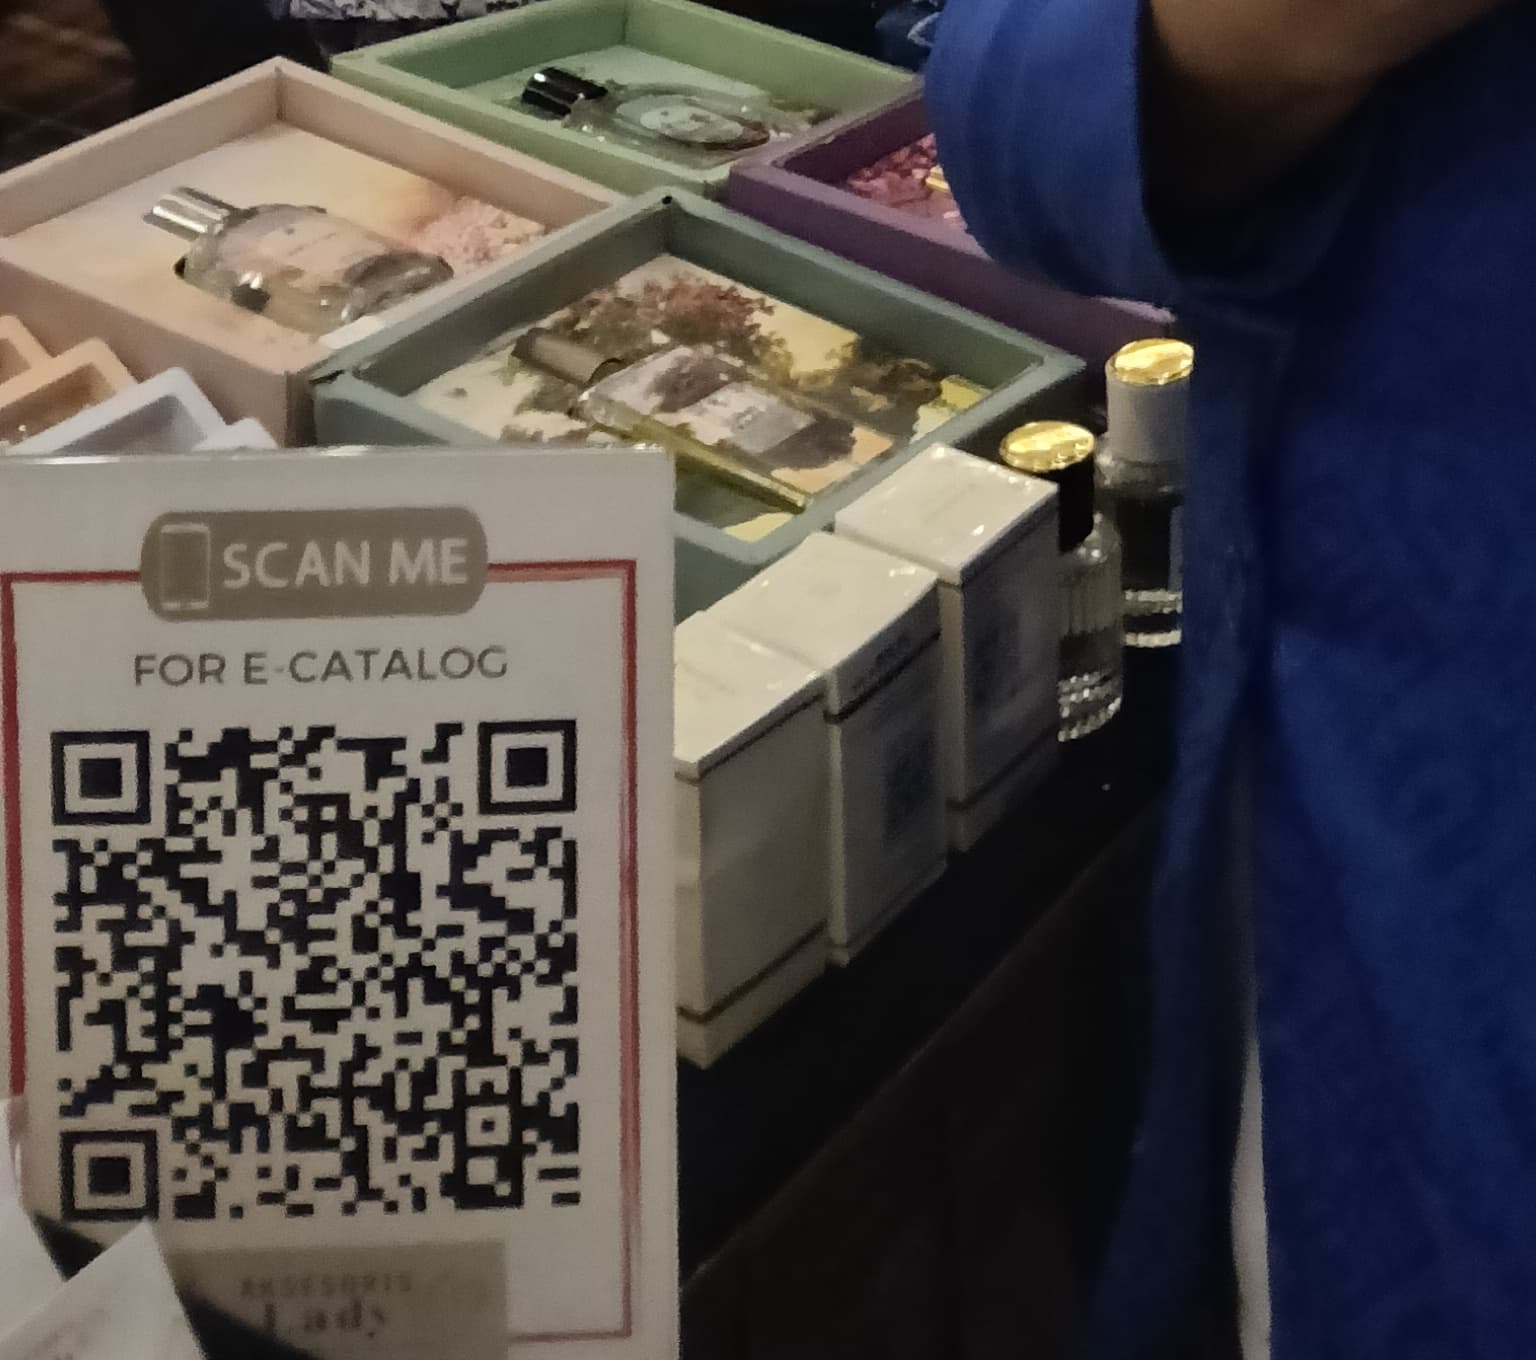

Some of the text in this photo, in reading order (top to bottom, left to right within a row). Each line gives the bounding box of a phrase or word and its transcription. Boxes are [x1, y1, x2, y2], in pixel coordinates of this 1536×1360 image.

[222, 537, 468, 589] SCAN ME
[134, 645, 508, 687] FOR E-CATALOG
